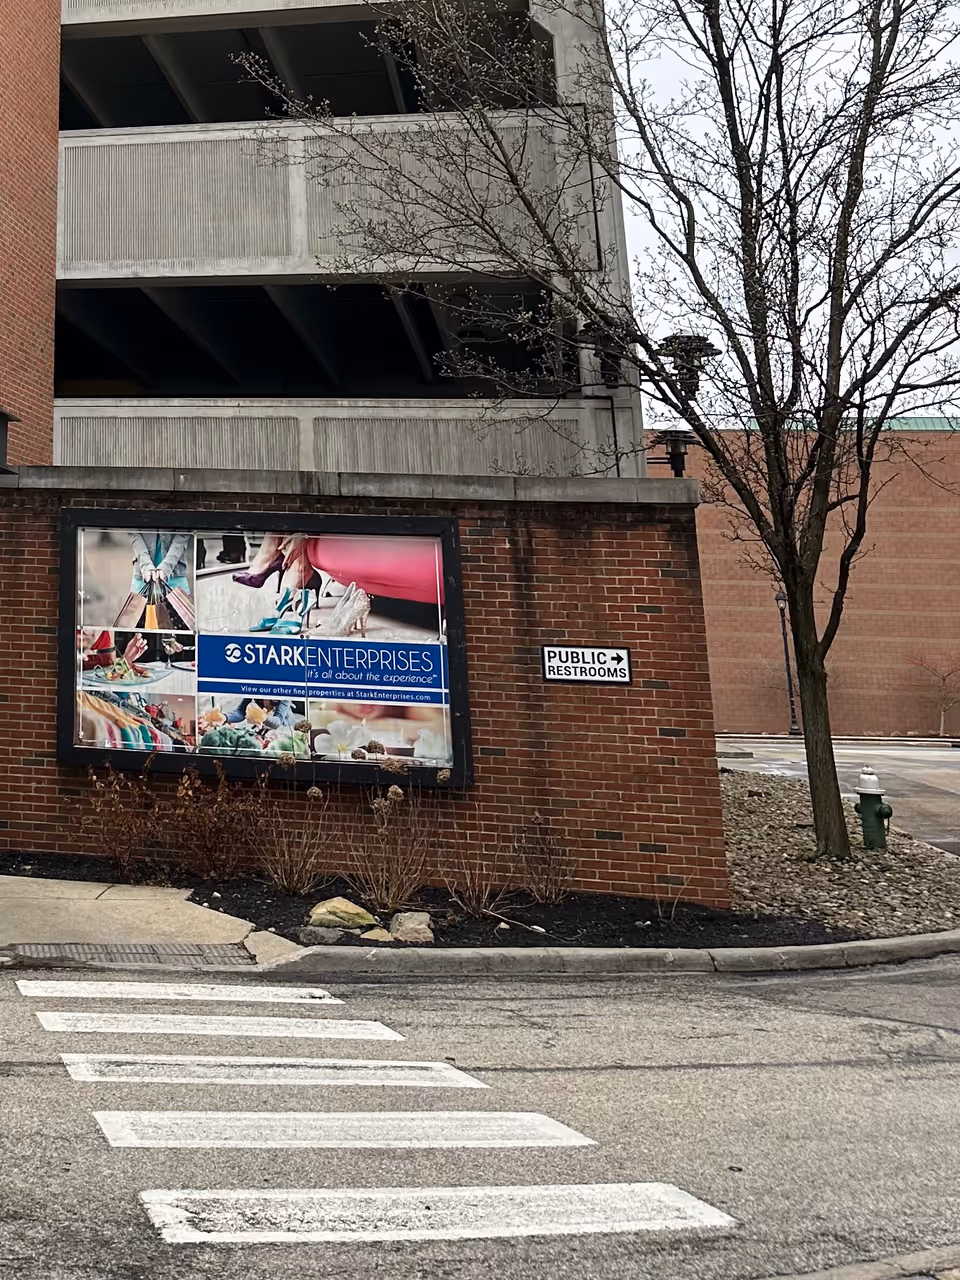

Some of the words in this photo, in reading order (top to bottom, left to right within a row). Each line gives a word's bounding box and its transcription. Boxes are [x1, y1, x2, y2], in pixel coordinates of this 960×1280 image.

[547, 650, 607, 665] PUBLIC
[307, 669, 319, 679] it's
[321, 670, 333, 679] all
[335, 671, 363, 680] about
[366, 672, 380, 681] the
[548, 665, 627, 678] RESTROOMS
[293, 687, 305, 695] fine
[308, 689, 345, 698] properties
[356, 691, 431, 701] StarkEnterprises.com
